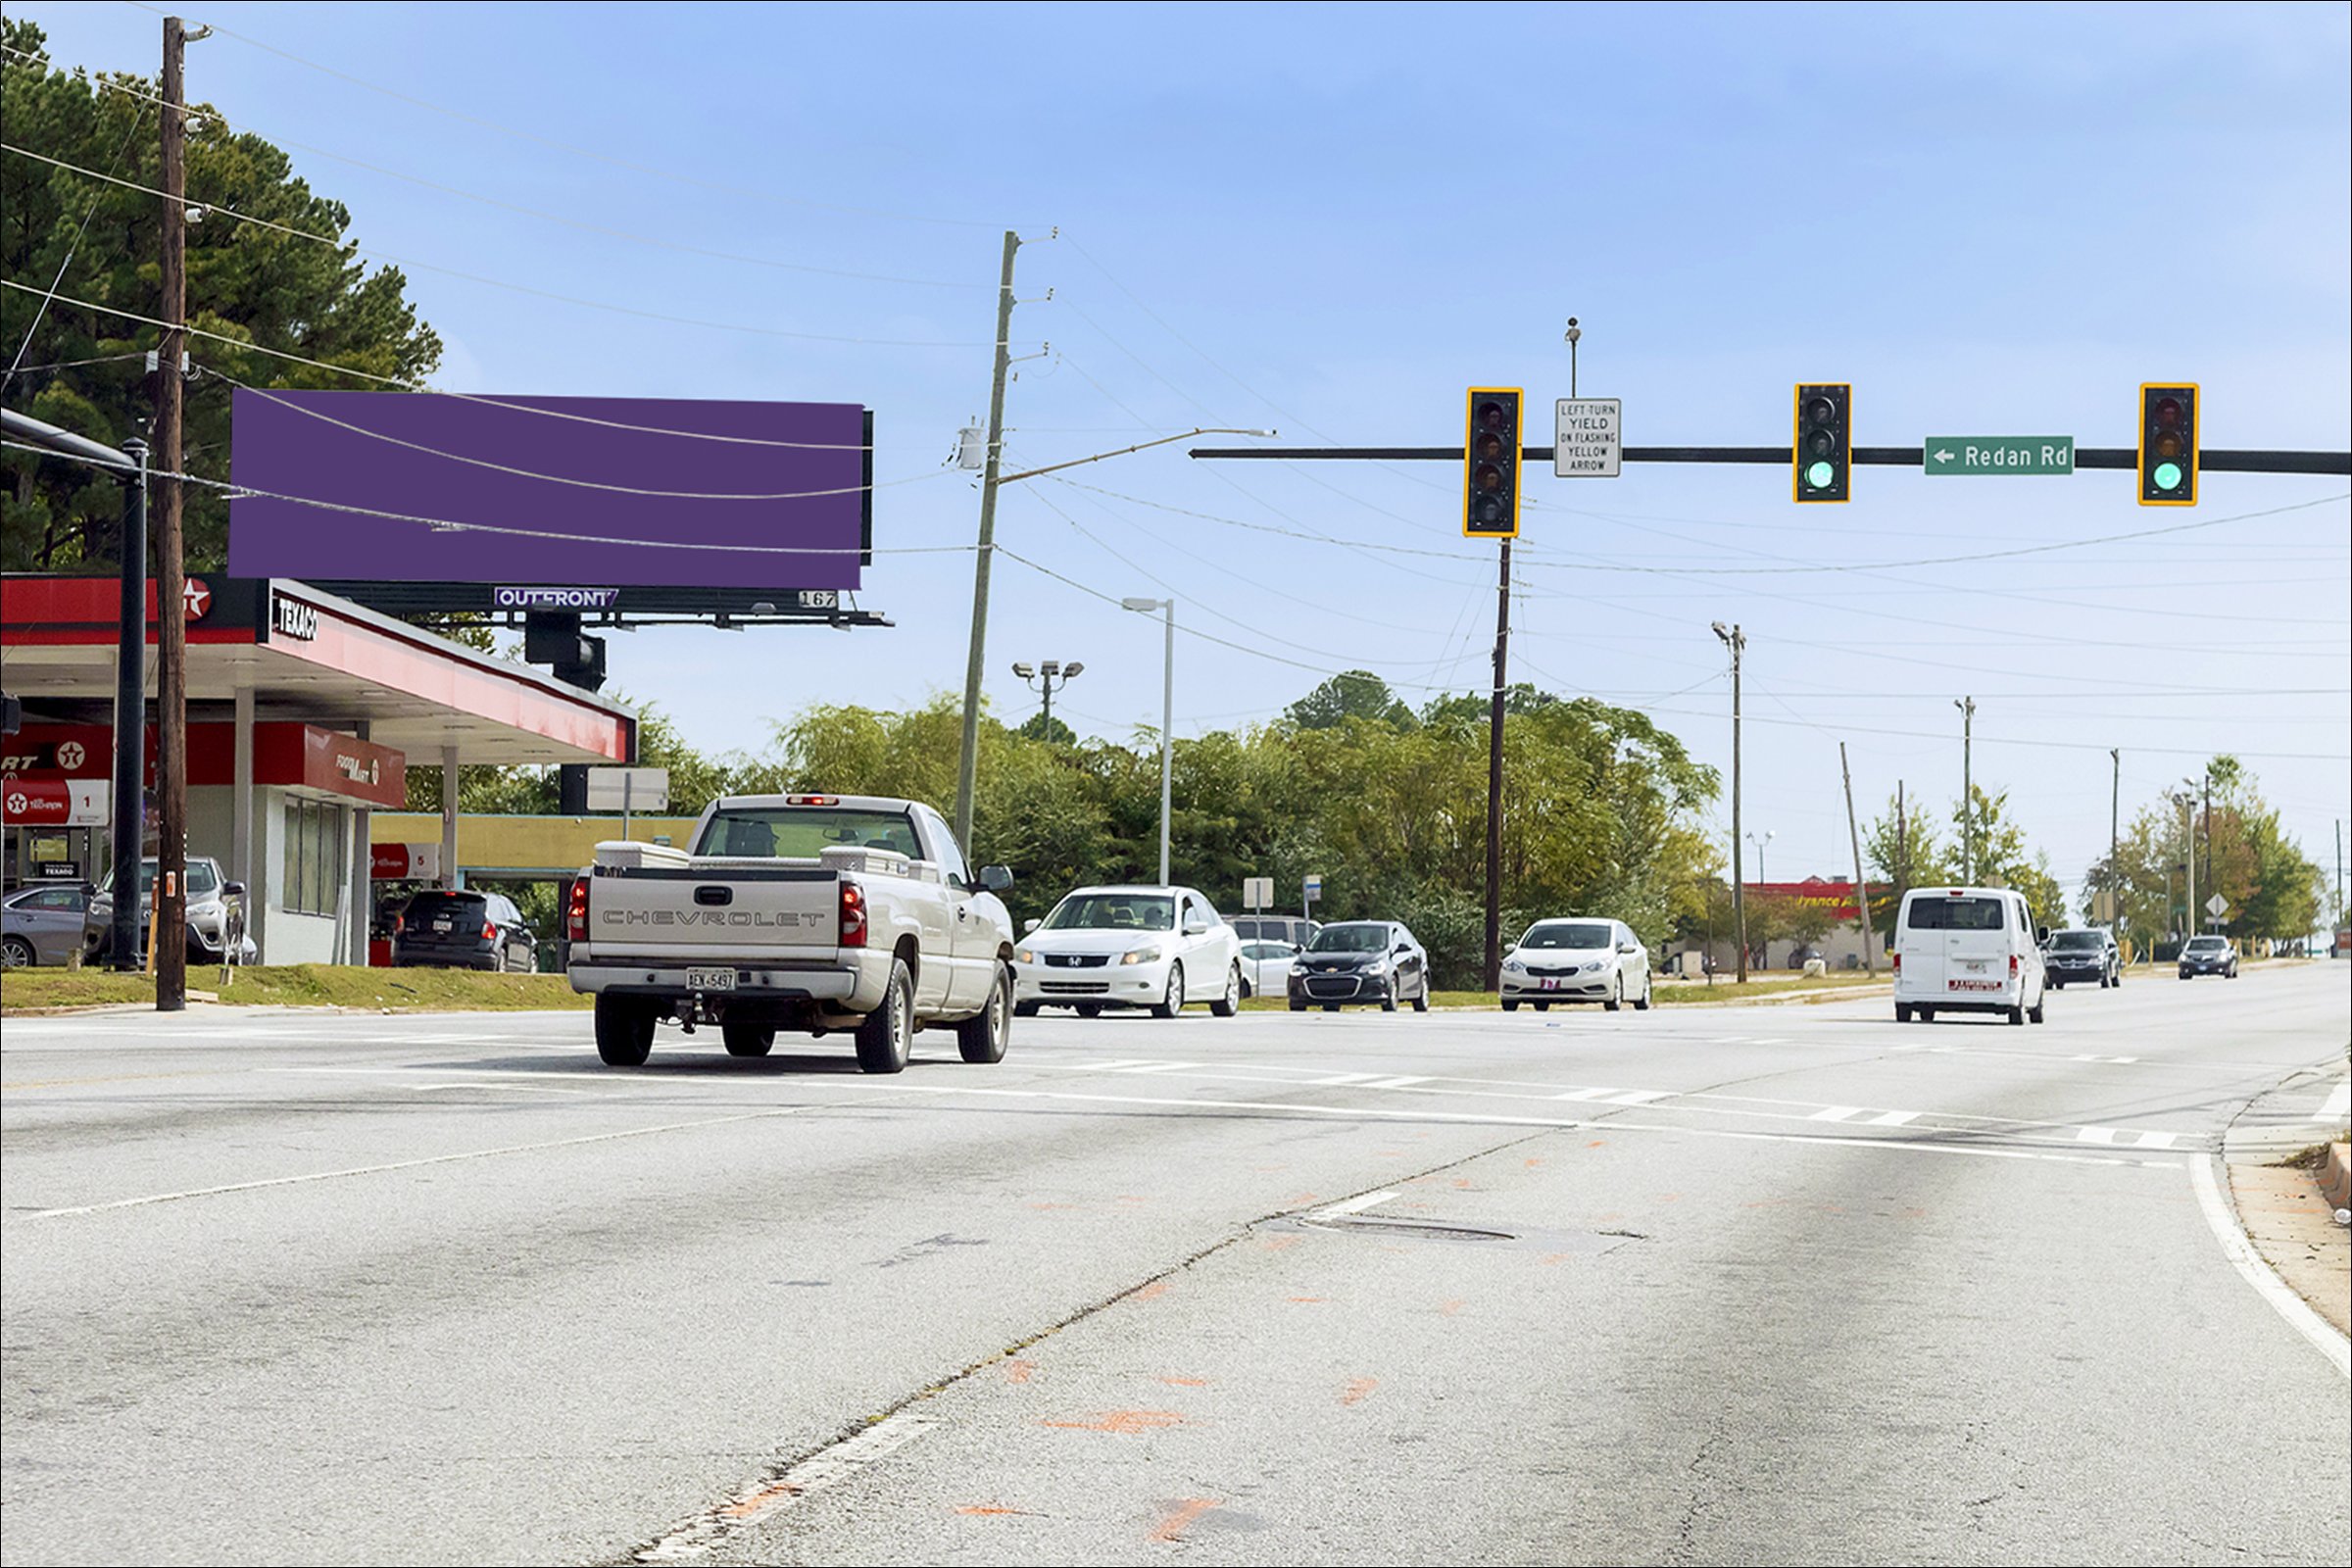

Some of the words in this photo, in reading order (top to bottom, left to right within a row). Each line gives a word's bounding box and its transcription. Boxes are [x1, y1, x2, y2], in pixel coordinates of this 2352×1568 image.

[1561, 405, 1585, 416] LEFT
[1589, 405, 1616, 416] TURN
[1569, 417, 1608, 429] YIELD
[1560, 433, 1572, 443] ON
[1575, 432, 1616, 443] FLASHING
[1568, 447, 1608, 458] YELLOW
[1966, 446, 2032, 466] Redan
[2041, 445, 2068, 466] Rd
[1570, 461, 1606, 470] ARROW
[499, 590, 607, 607] OUTFRONT
[801, 591, 836, 606] 167
[279, 598, 319, 642] TEXACO
[603, 910, 825, 927] CHEVROLET
